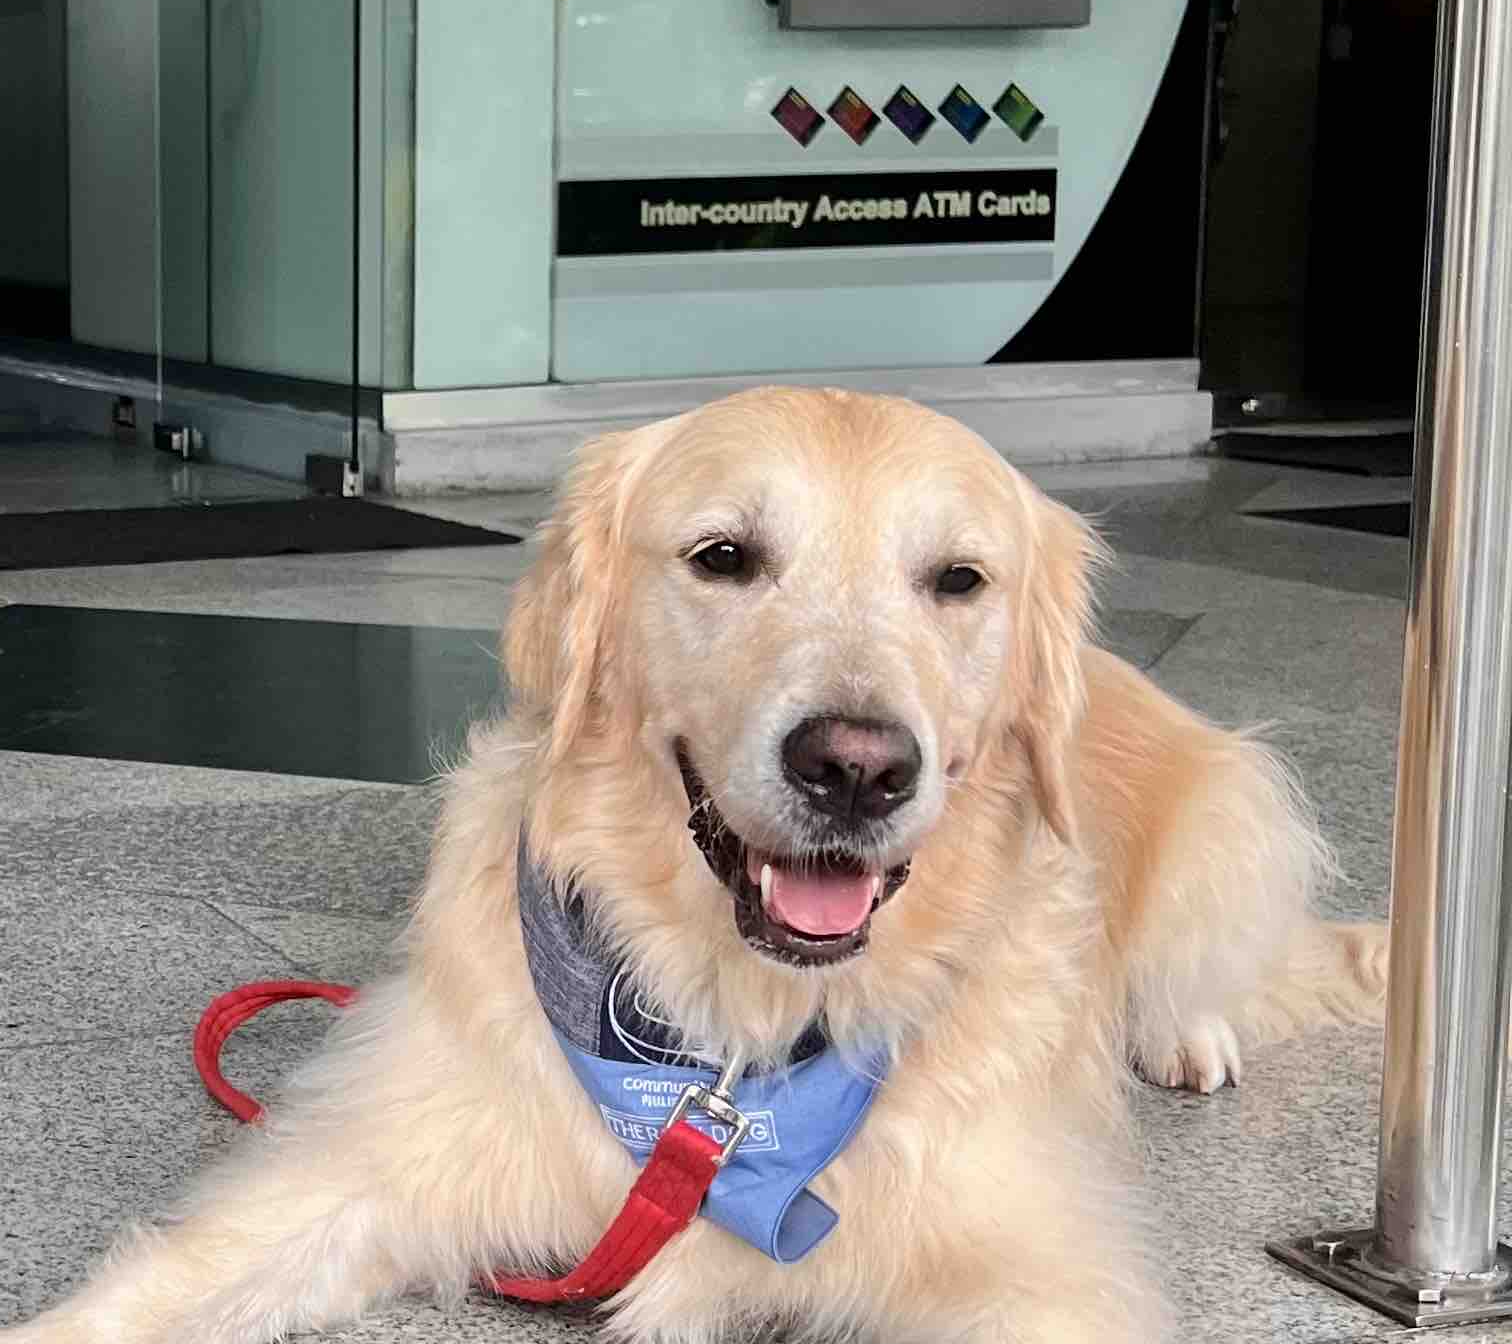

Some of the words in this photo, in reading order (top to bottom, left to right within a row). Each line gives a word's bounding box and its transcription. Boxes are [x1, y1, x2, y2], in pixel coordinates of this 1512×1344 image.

[640, 199, 809, 229] Inter-country
[813, 194, 907, 222] Access
[913, 191, 972, 219] ATM
[977, 189, 1051, 217] Cards
[711, 1122, 768, 1145] DG
